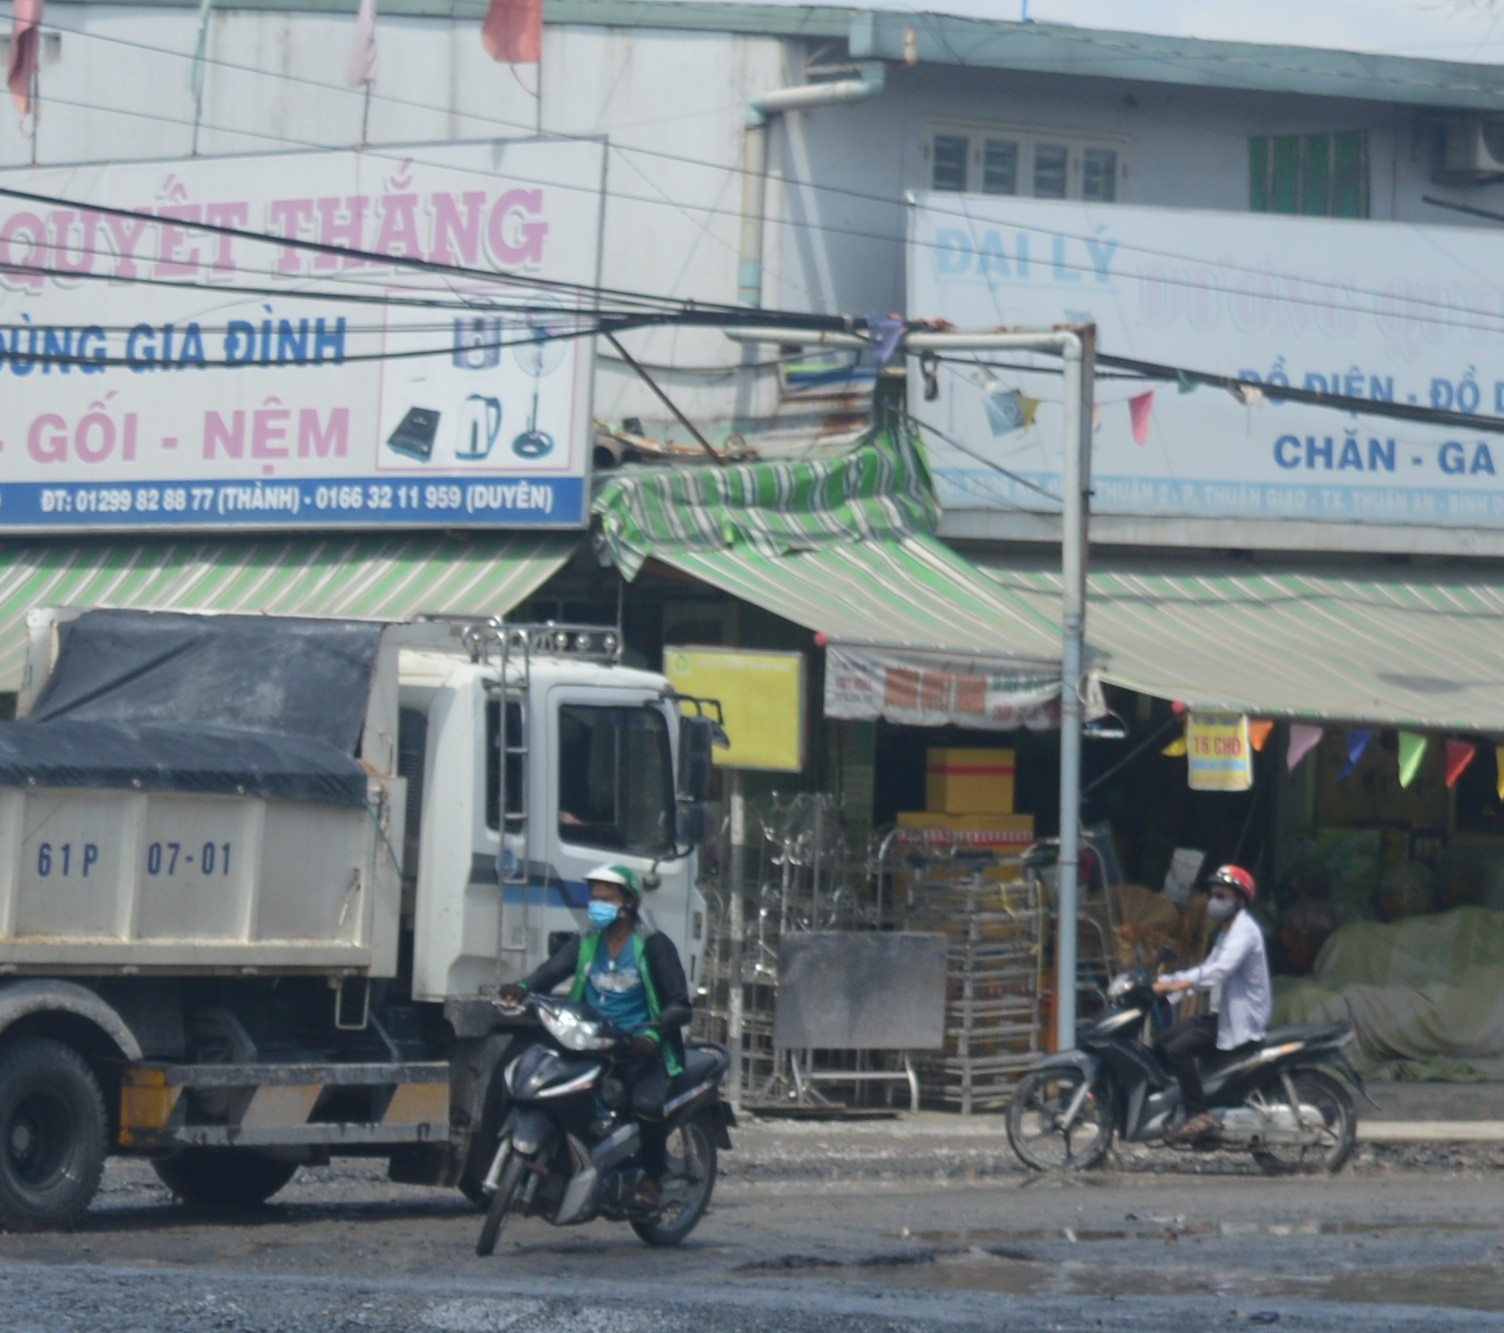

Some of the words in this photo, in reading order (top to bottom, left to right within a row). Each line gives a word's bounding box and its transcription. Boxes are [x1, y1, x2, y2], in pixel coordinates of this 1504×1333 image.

[269, 158, 551, 277] THẮNG
[935, 228, 1030, 292] ĐẠI
[1052, 224, 1120, 284] LÝ
[125, 322, 206, 373] GIA
[225, 304, 346, 369] ĐÌNH
[26, 390, 139, 465] GỐI
[202, 396, 351, 476] NỆM
[1272, 427, 1397, 473] CHĂN
[1437, 441, 1497, 477] GA
[75, 488, 132, 513] 01299
[135, 487, 160, 512] 82
[162, 487, 187, 512] 88
[191, 487, 215, 511] 77
[217, 480, 301, 515] (THÀNH)
[314, 484, 363, 510] 0166
[366, 484, 393, 509] 32
[398, 485, 419, 509] 11
[424, 484, 463, 509] 959
[465, 480, 554, 515] (DUYÊN)
[146, 841, 233, 877] 07-01
